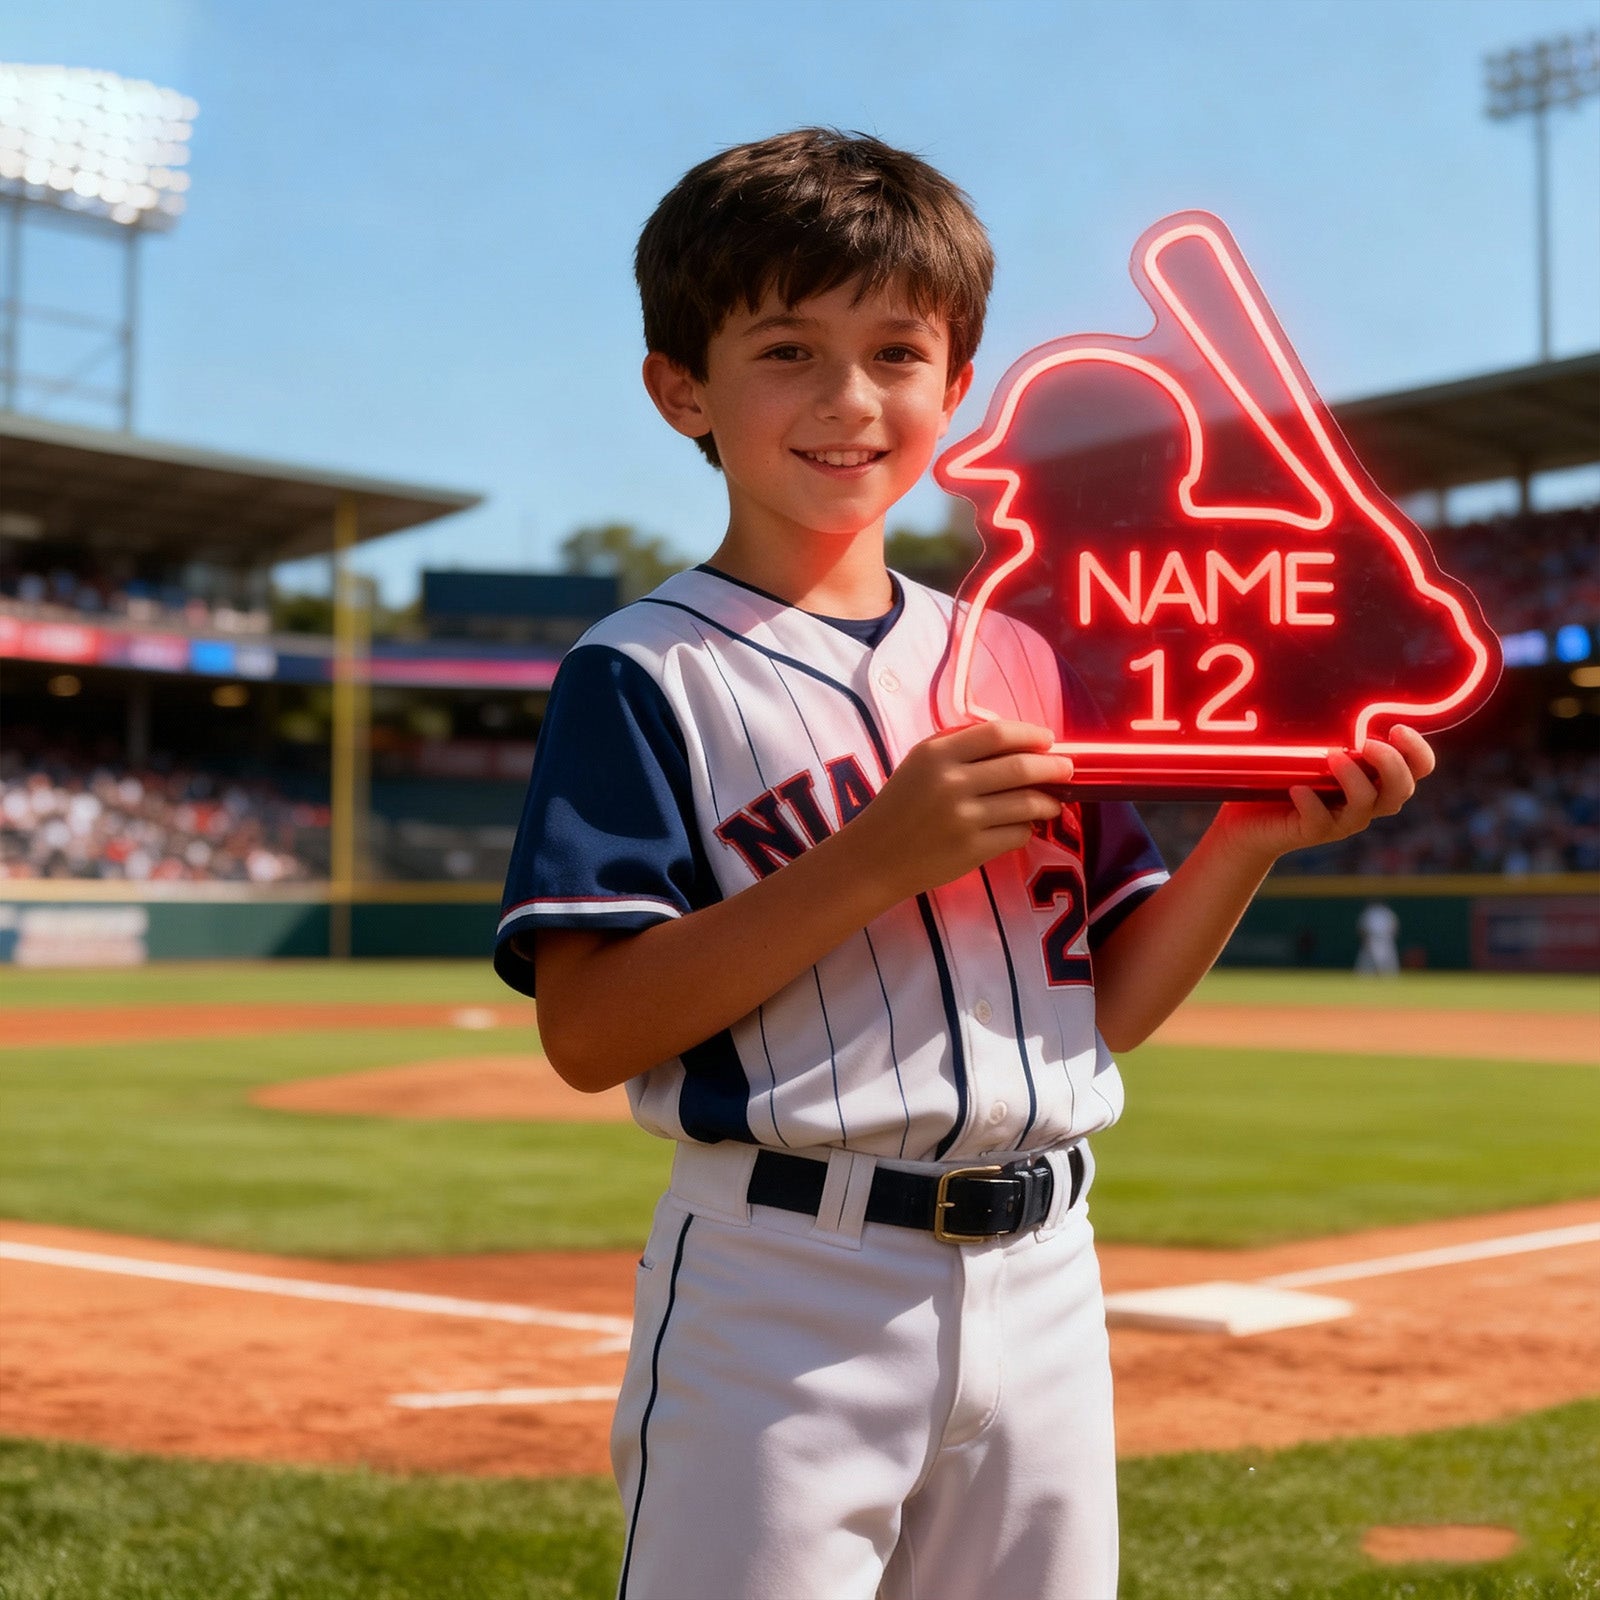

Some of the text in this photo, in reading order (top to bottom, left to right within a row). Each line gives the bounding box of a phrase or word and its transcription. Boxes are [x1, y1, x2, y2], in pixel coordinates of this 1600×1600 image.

[1079, 550, 1335, 626] NAME
[1129, 643, 1258, 732] 12
[1026, 865, 1094, 988] 2
